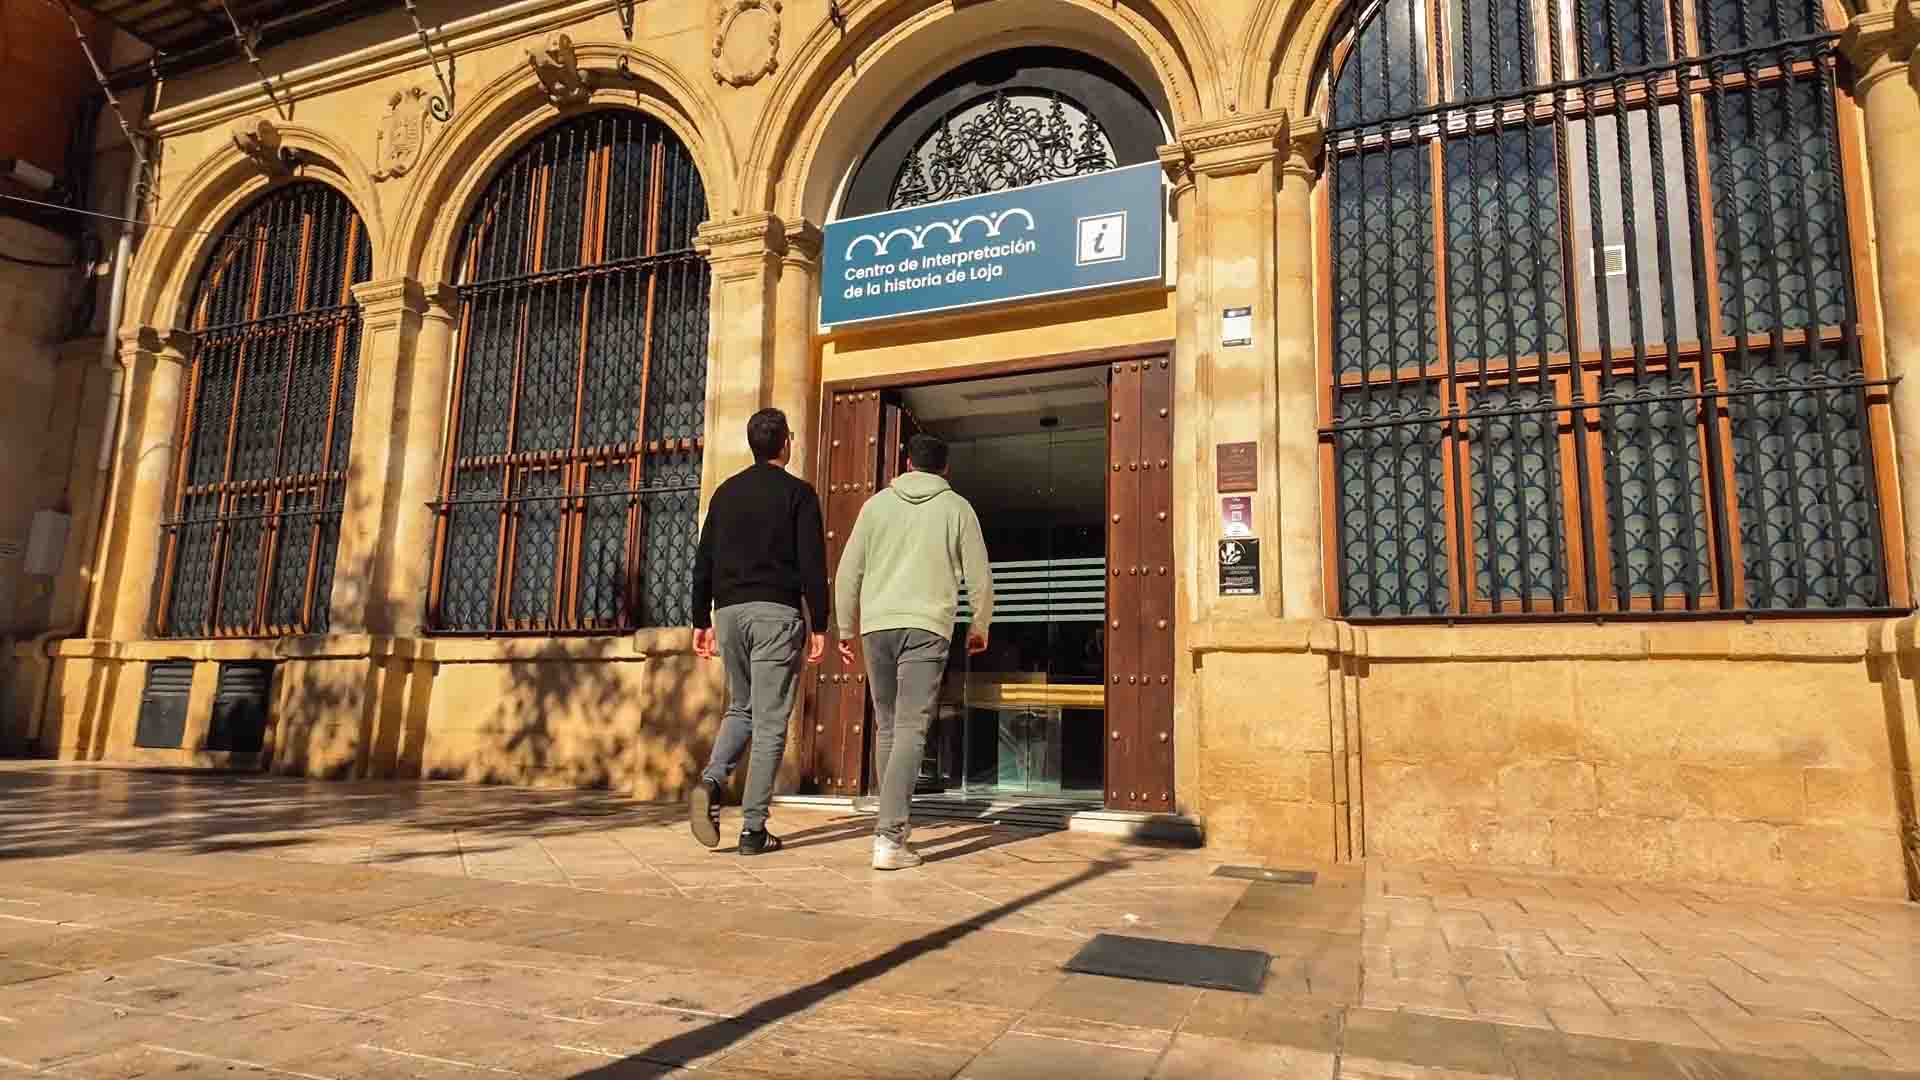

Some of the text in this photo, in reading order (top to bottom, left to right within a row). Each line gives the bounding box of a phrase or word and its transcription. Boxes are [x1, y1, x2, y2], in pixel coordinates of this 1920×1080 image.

[844, 237, 1036, 281] Centro de Interpretación
[843, 263, 1003, 299] de la historia de Loja
